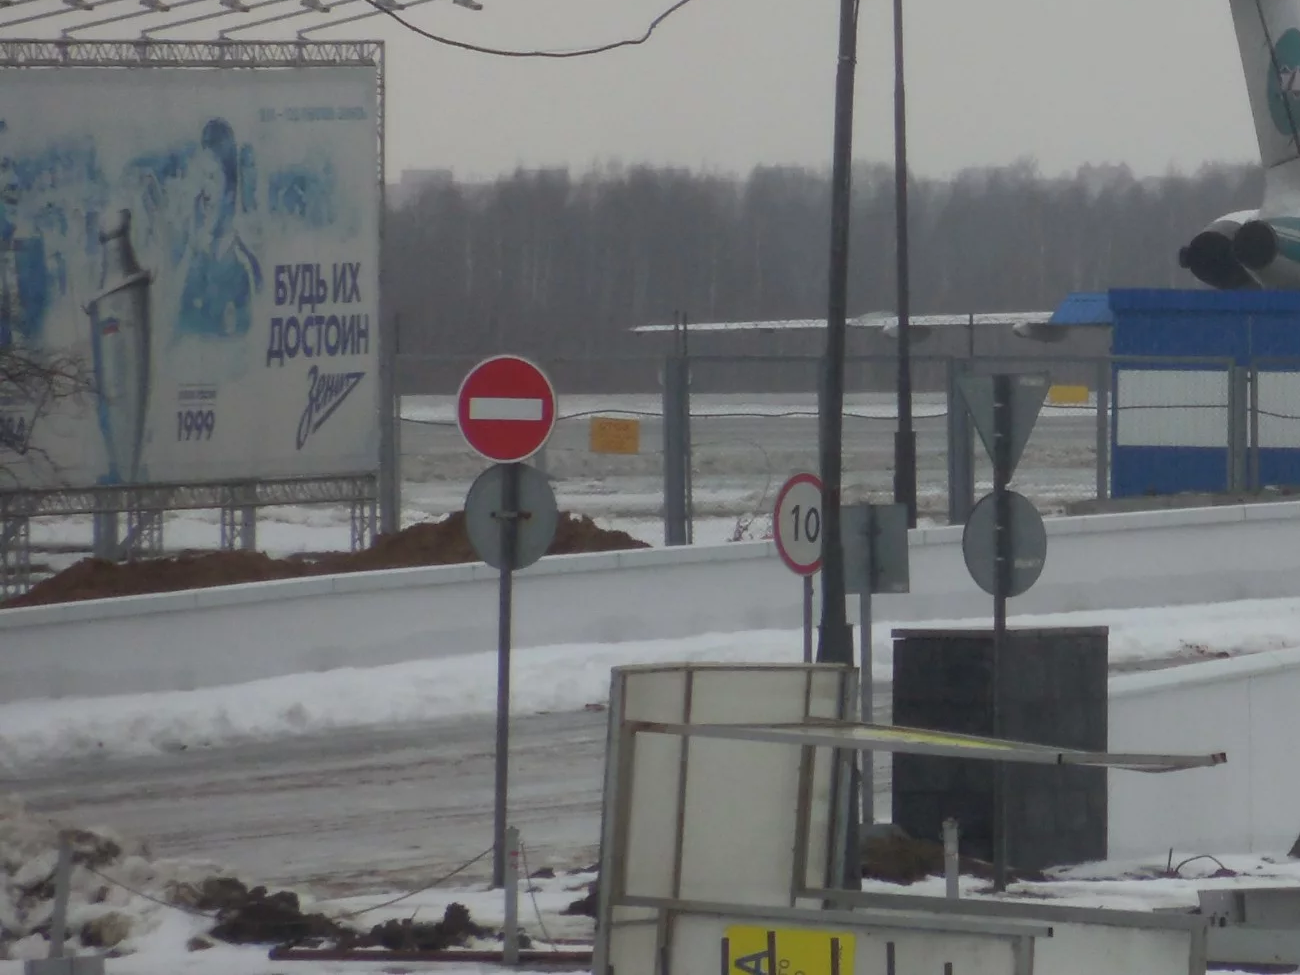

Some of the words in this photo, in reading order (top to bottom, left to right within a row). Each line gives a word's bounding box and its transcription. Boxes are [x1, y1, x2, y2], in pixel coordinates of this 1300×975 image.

[274, 264, 328, 313] БУДЬ
[332, 262, 361, 303] ИХ
[266, 314, 369, 367] ДОСТОИН
[177, 409, 215, 441] 1999
[791, 505, 820, 543] 10
